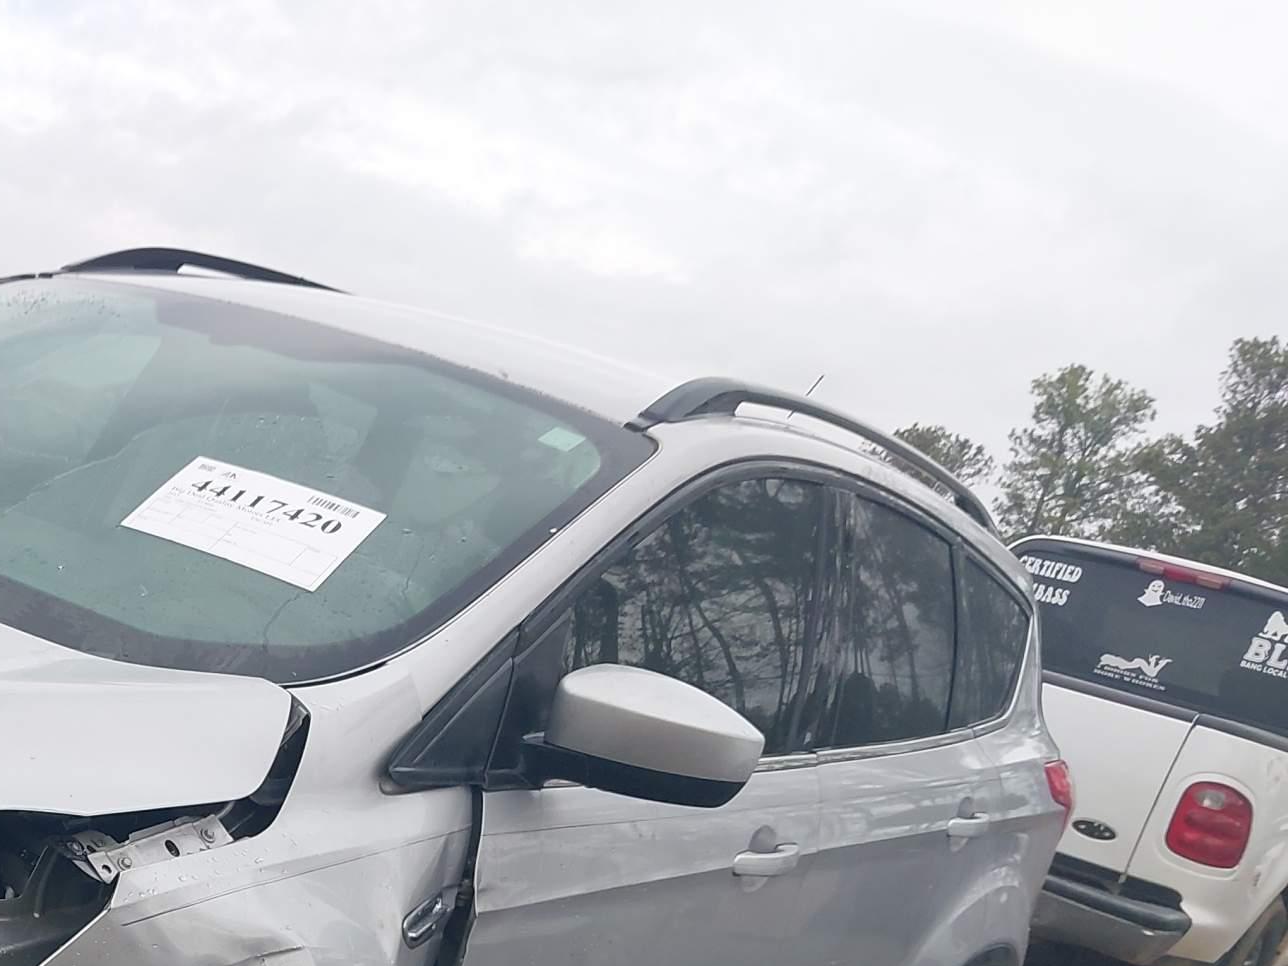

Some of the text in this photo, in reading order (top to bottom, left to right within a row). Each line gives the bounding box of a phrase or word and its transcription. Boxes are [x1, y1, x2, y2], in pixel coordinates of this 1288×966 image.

[191, 480, 343, 535] 44117420
[1033, 583, 1071, 606] BASS
[1240, 660, 1263, 671] BANG
[1243, 636, 1288, 670] BL
